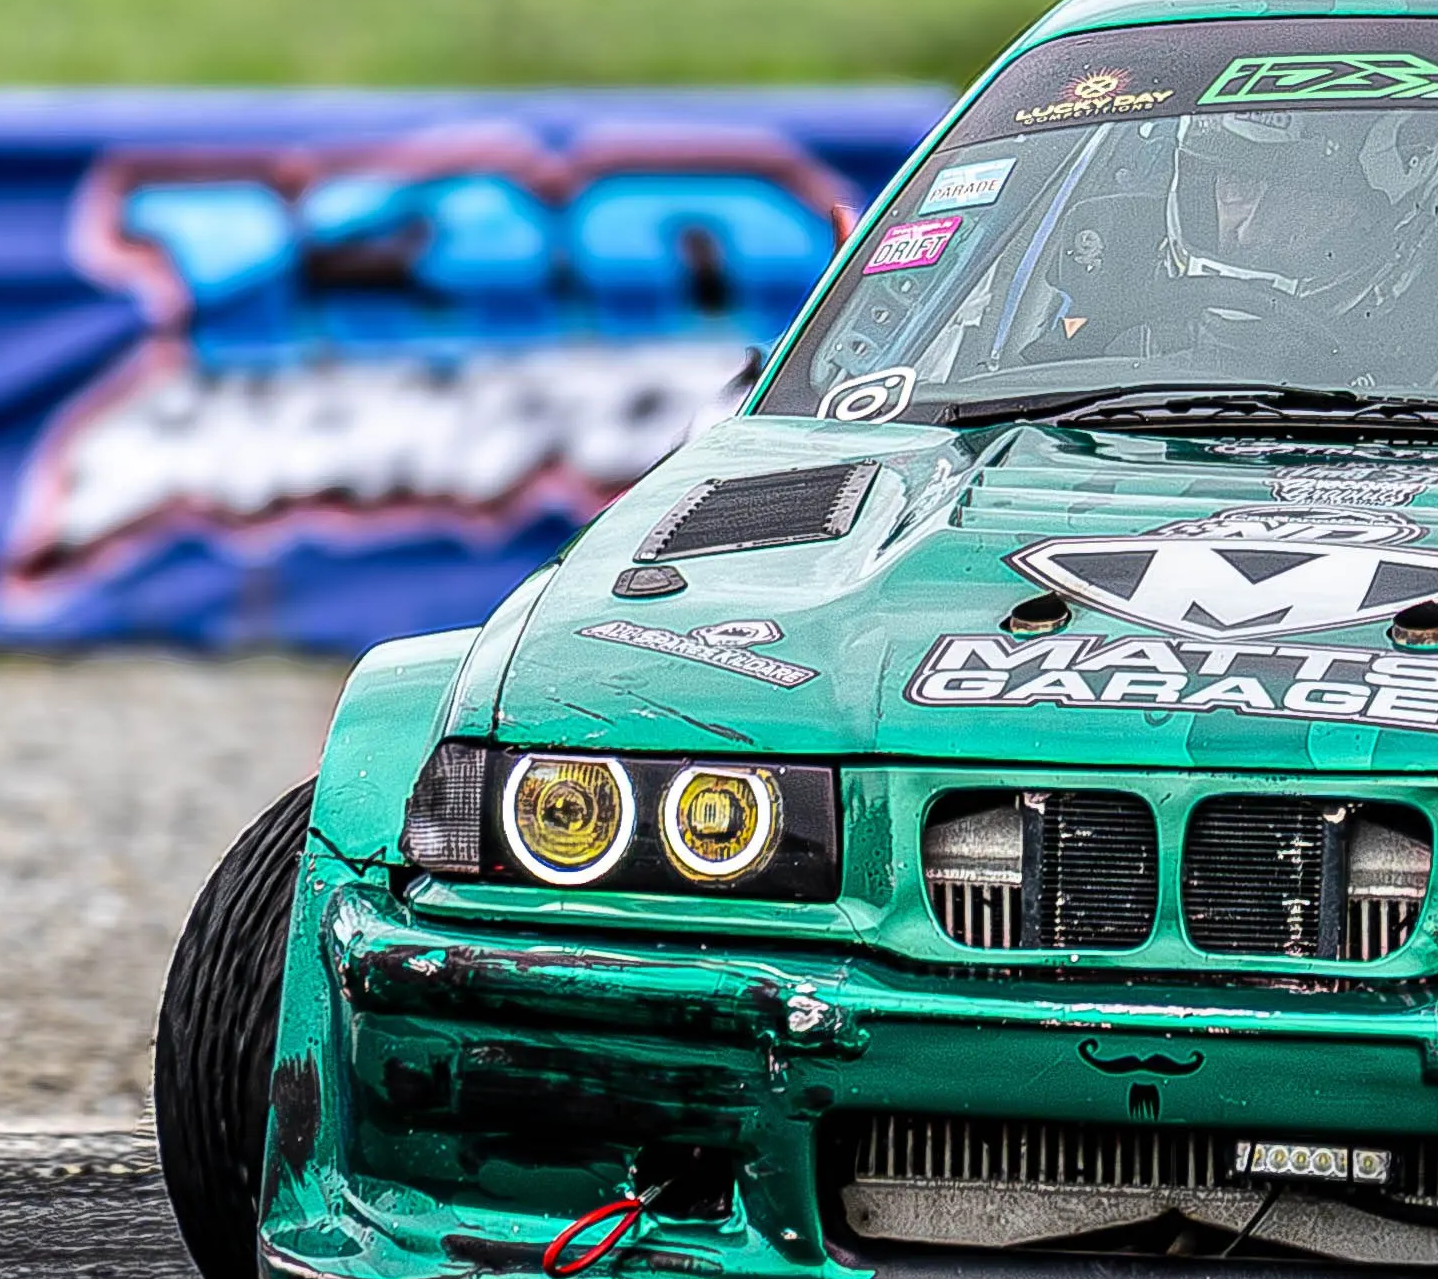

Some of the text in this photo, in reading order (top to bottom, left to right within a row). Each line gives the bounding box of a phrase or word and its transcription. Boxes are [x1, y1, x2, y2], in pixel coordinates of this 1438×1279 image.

[1015, 89, 1175, 122] LUCKY DAY
[1022, 102, 1154, 126] COMPETITIONS
[930, 179, 999, 202] PARADE
[873, 235, 947, 265] DRIFT
[714, 648, 807, 684] KILDARE
